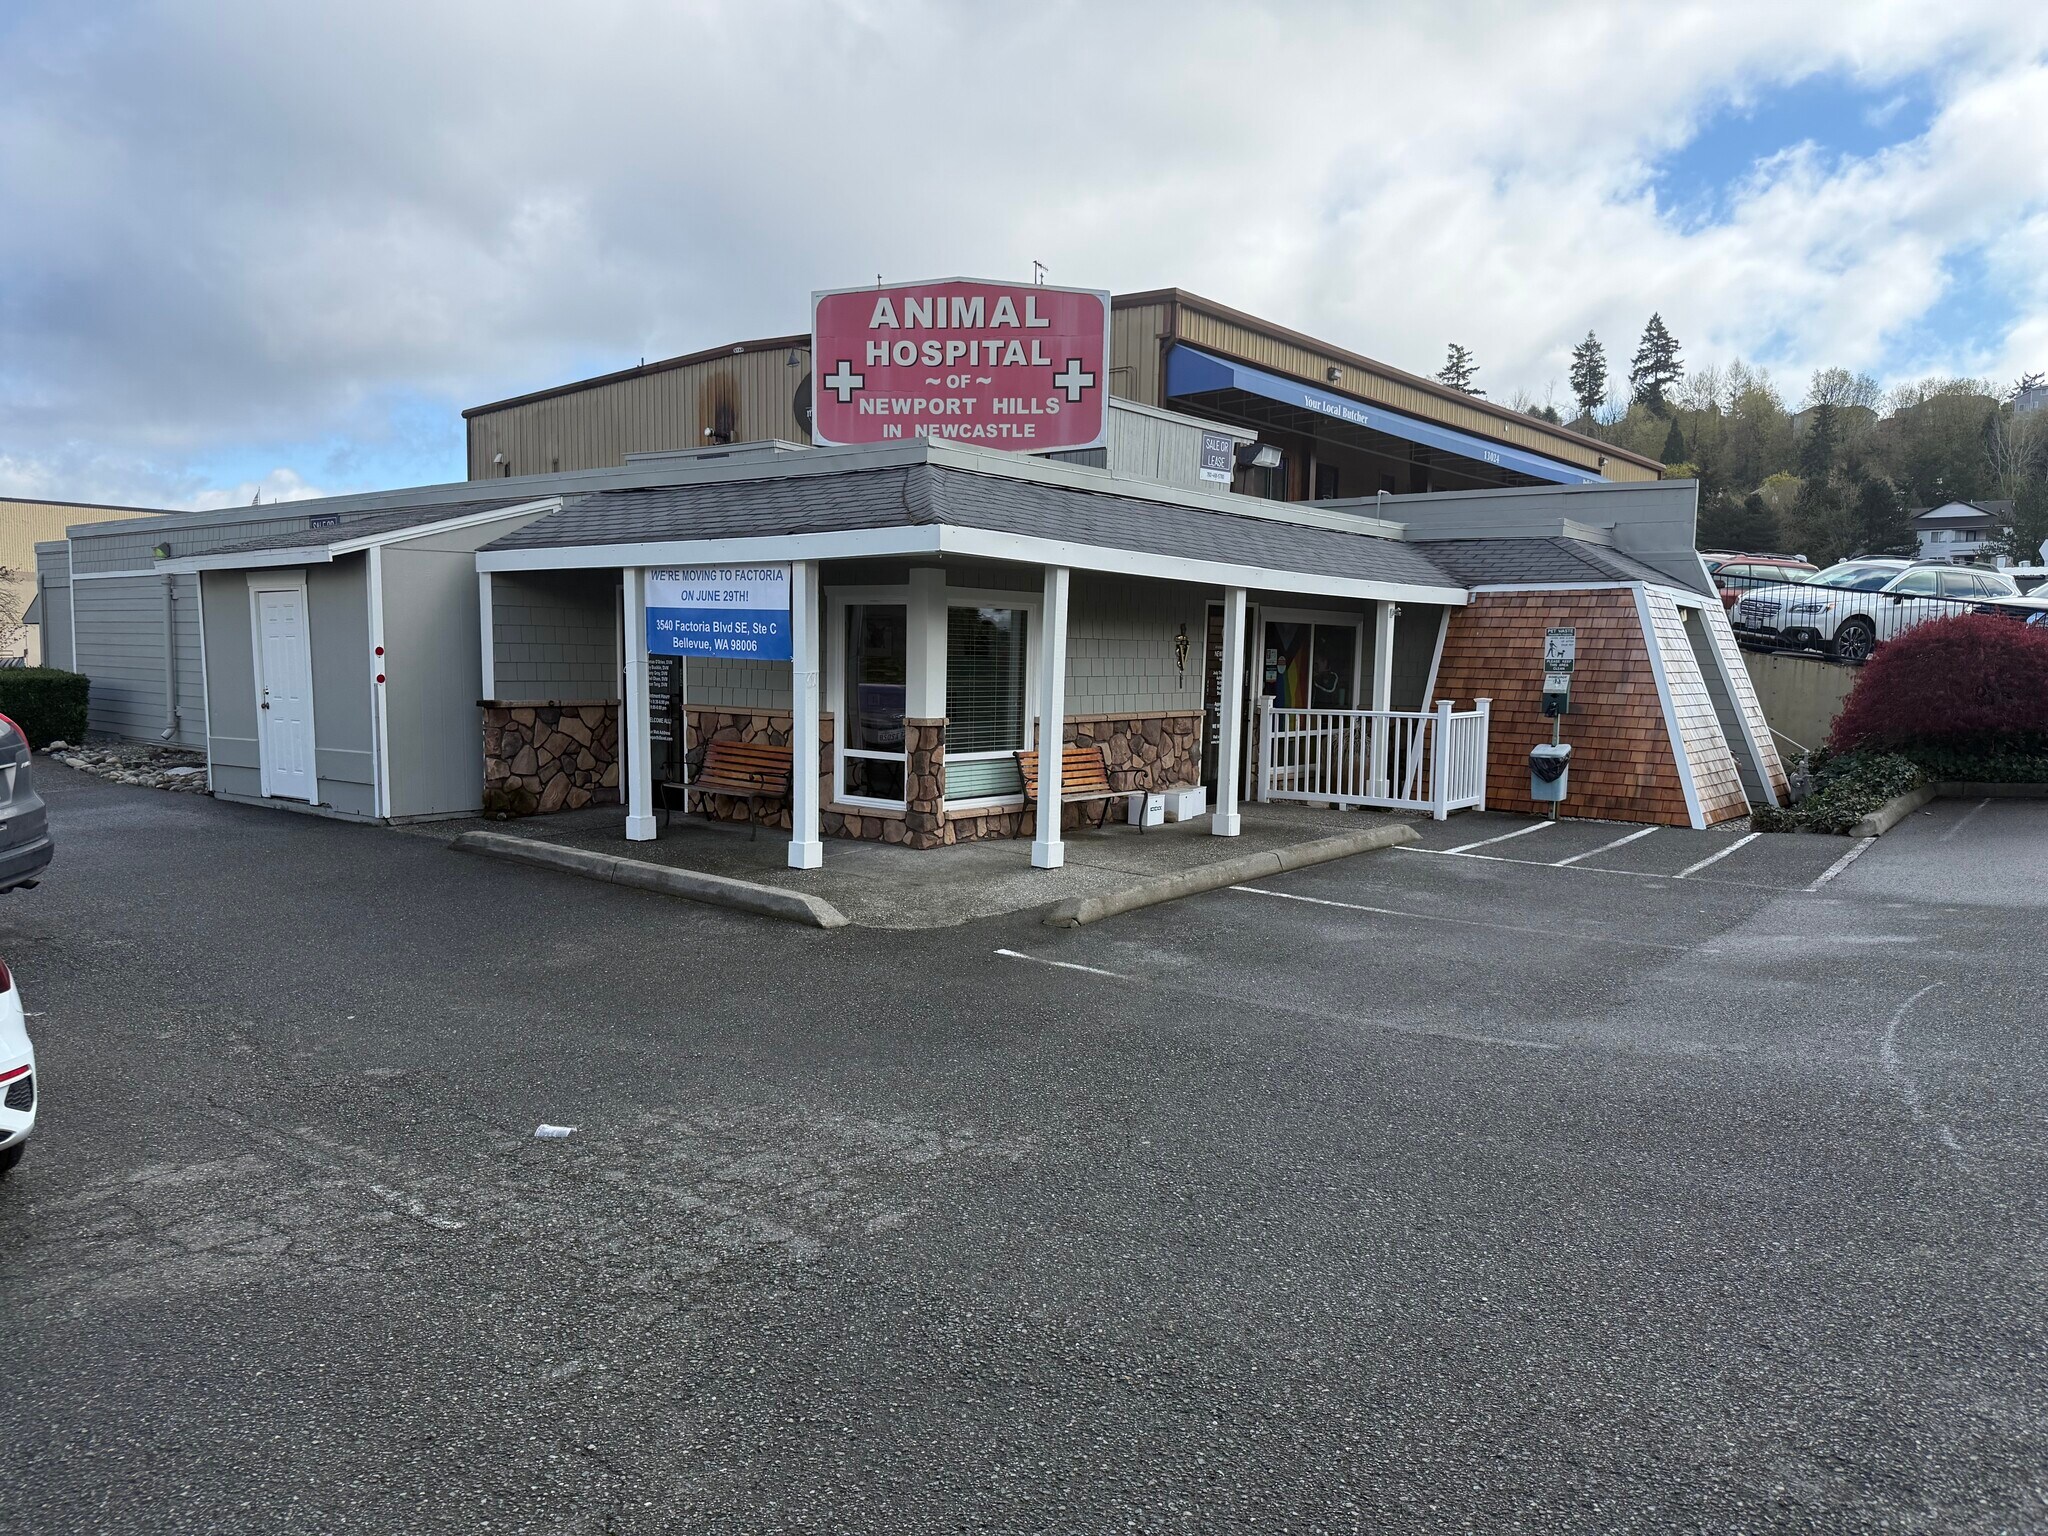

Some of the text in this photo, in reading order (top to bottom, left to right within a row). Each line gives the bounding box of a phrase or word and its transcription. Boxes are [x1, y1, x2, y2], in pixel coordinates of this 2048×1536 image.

[868, 296, 1050, 330] ANIMAL
[866, 339, 1052, 367] HOSPITAL
[946, 374, 971, 389] OF
[859, 397, 1060, 415] NEWPORT HILLS
[1304, 395, 1369, 424] Your Local Butcher
[883, 423, 1036, 438] IN NEWCASTLE
[1205, 438, 1229, 453] SALE OR
[1207, 455, 1226, 468] LEASE
[1483, 450, 1500, 464] 13024
[651, 569, 784, 581] WE'RE MOVING TO FACTORIA
[681, 590, 749, 602] ON JUNE 29TH!
[656, 619, 777, 635] 3540 Factoria Blvd SE, Ste C
[672, 637, 758, 652] Bellevue, WA 98006
